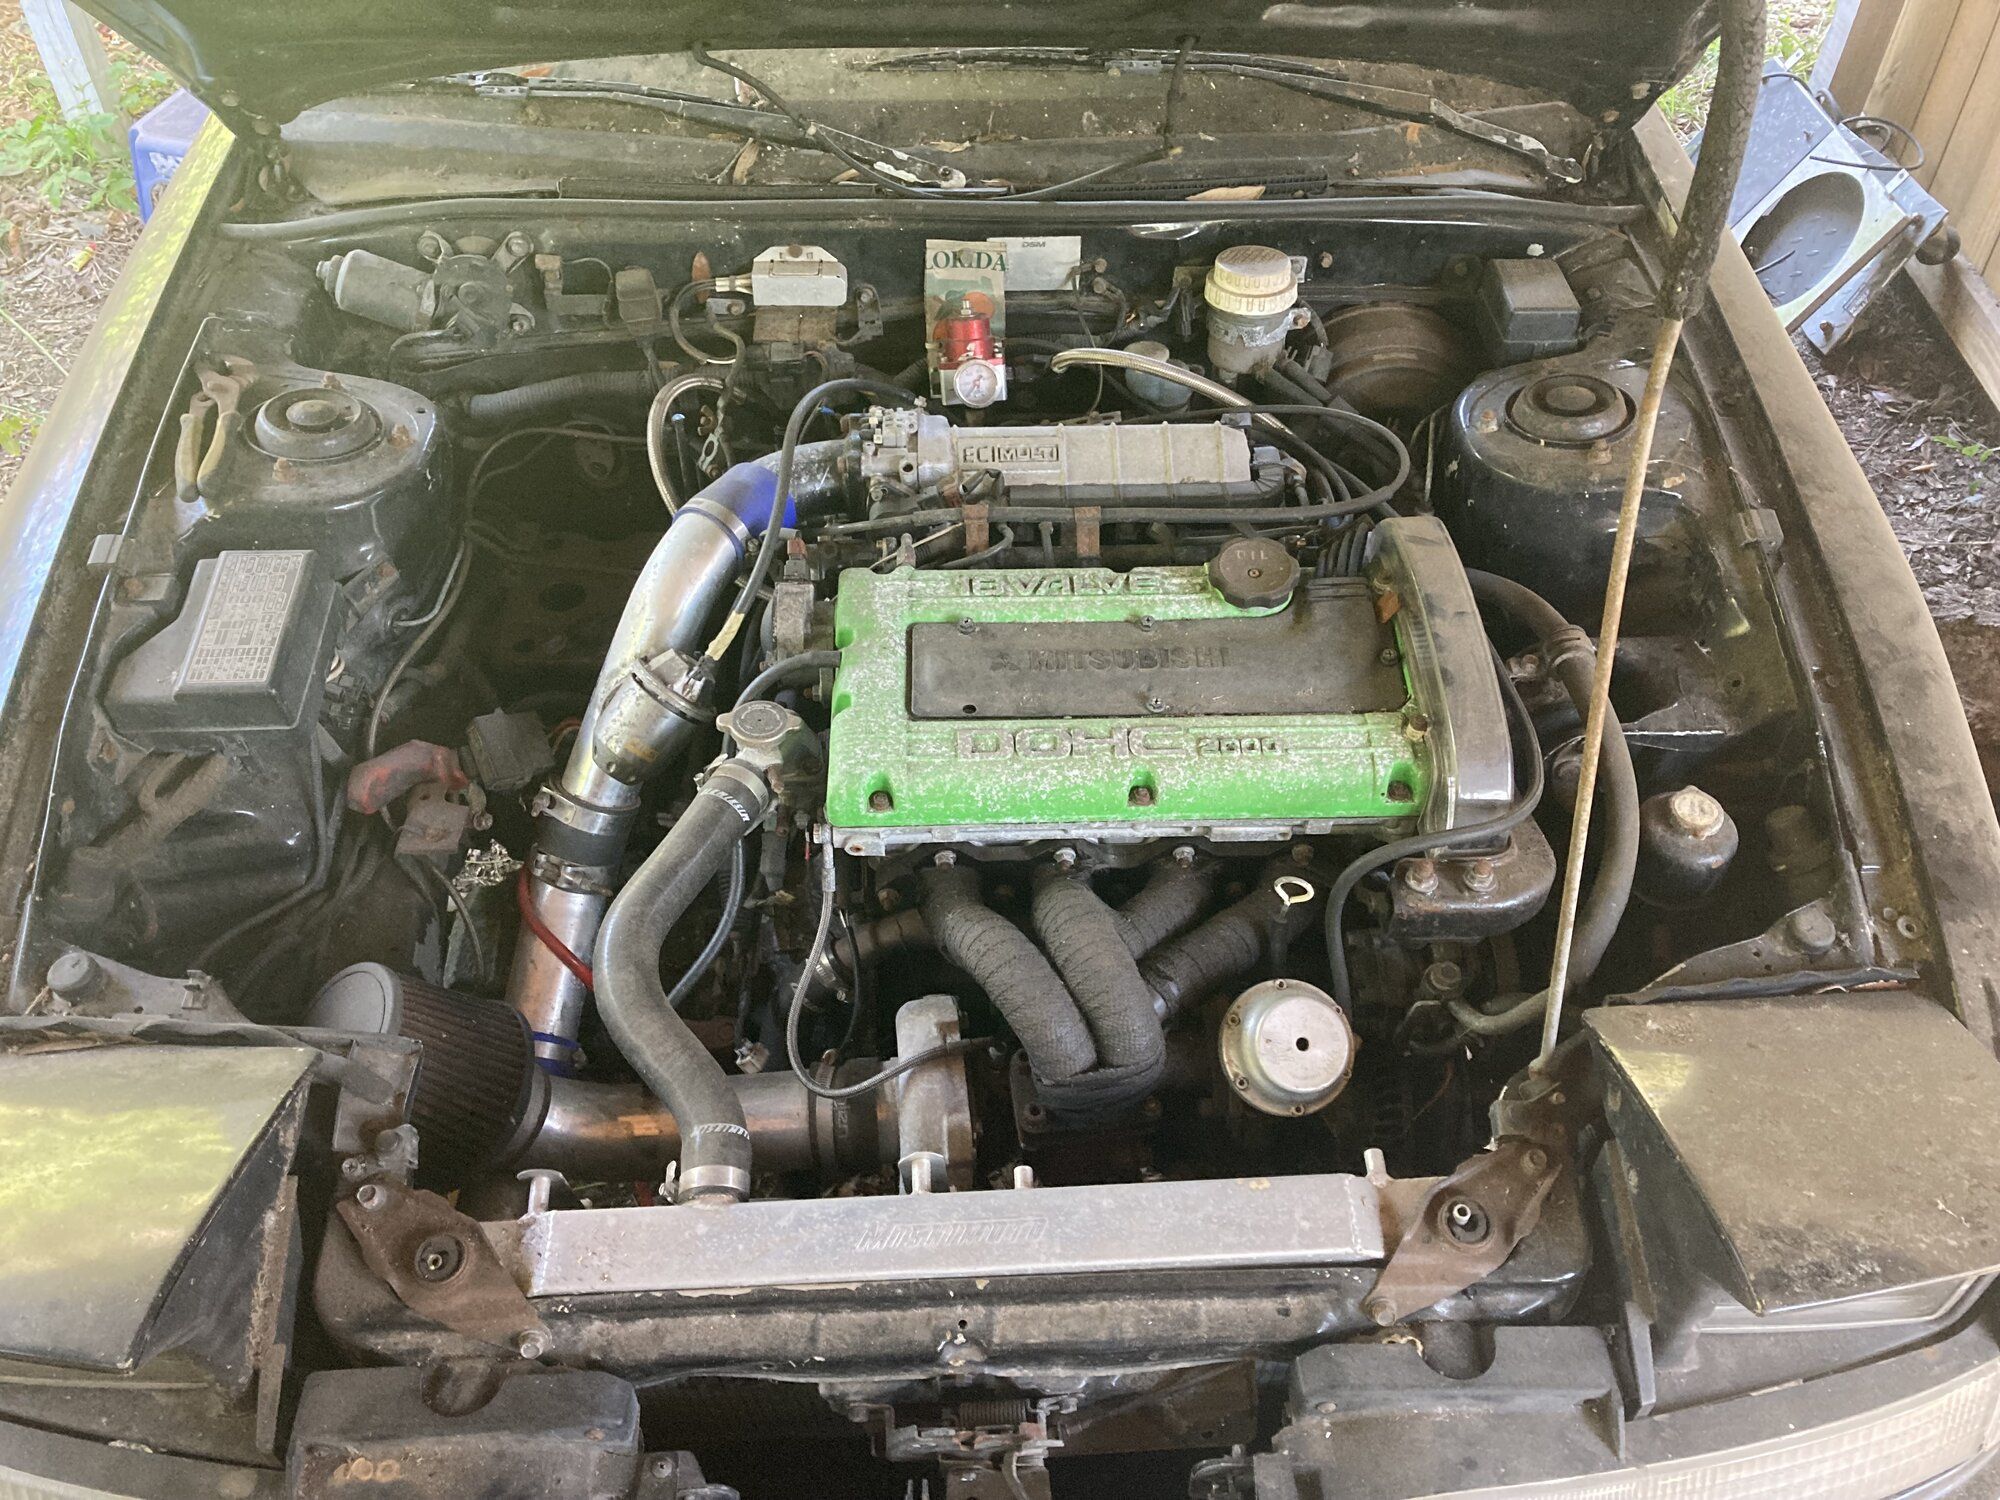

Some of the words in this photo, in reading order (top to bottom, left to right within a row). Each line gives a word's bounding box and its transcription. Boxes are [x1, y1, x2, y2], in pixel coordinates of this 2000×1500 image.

[1236, 549, 1268, 560] OIL
[1029, 649, 1231, 671] MITSUBISHI
[956, 727, 1188, 759] DOHC
